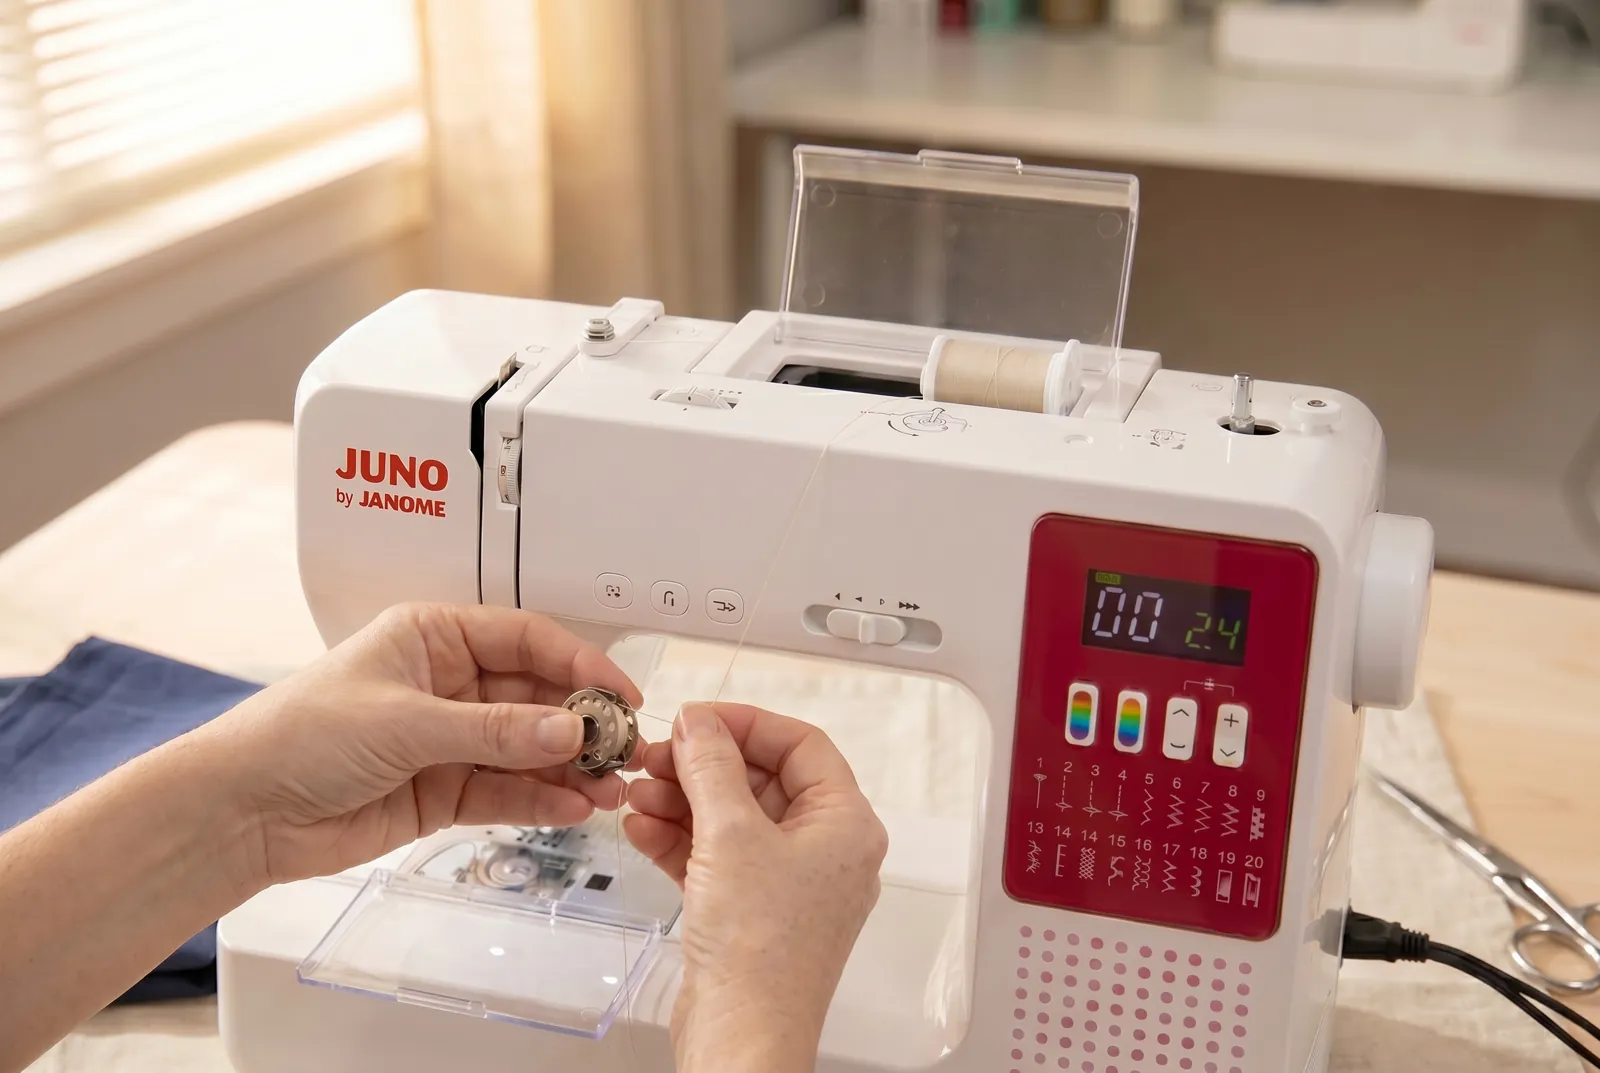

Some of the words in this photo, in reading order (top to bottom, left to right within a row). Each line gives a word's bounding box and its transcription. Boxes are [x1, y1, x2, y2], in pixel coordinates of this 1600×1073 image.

[335, 447, 449, 492] JUNO
[336, 488, 354, 508] by
[358, 490, 446, 518] JANOME
[1092, 586, 1163, 643] 00
[1036, 757, 1043, 769] 1
[1063, 761, 1073, 773] 2
[1090, 764, 1100, 777] 3
[1117, 769, 1128, 781] 4
[1144, 772, 1154, 785] 5
[1172, 776, 1182, 790] 6
[1201, 781, 1211, 794] 7
[1227, 784, 1238, 798] 8
[1256, 789, 1266, 802] 9
[1027, 820, 1044, 834] 13
[1054, 825, 1072, 839] 14
[1081, 829, 1098, 843] 14
[1108, 833, 1126, 848] 15
[1134, 837, 1152, 852] 16
[1162, 842, 1181, 856] 17
[1189, 846, 1208, 860] 18
[1218, 851, 1236, 865] 19
[1244, 854, 1264, 869] 20
